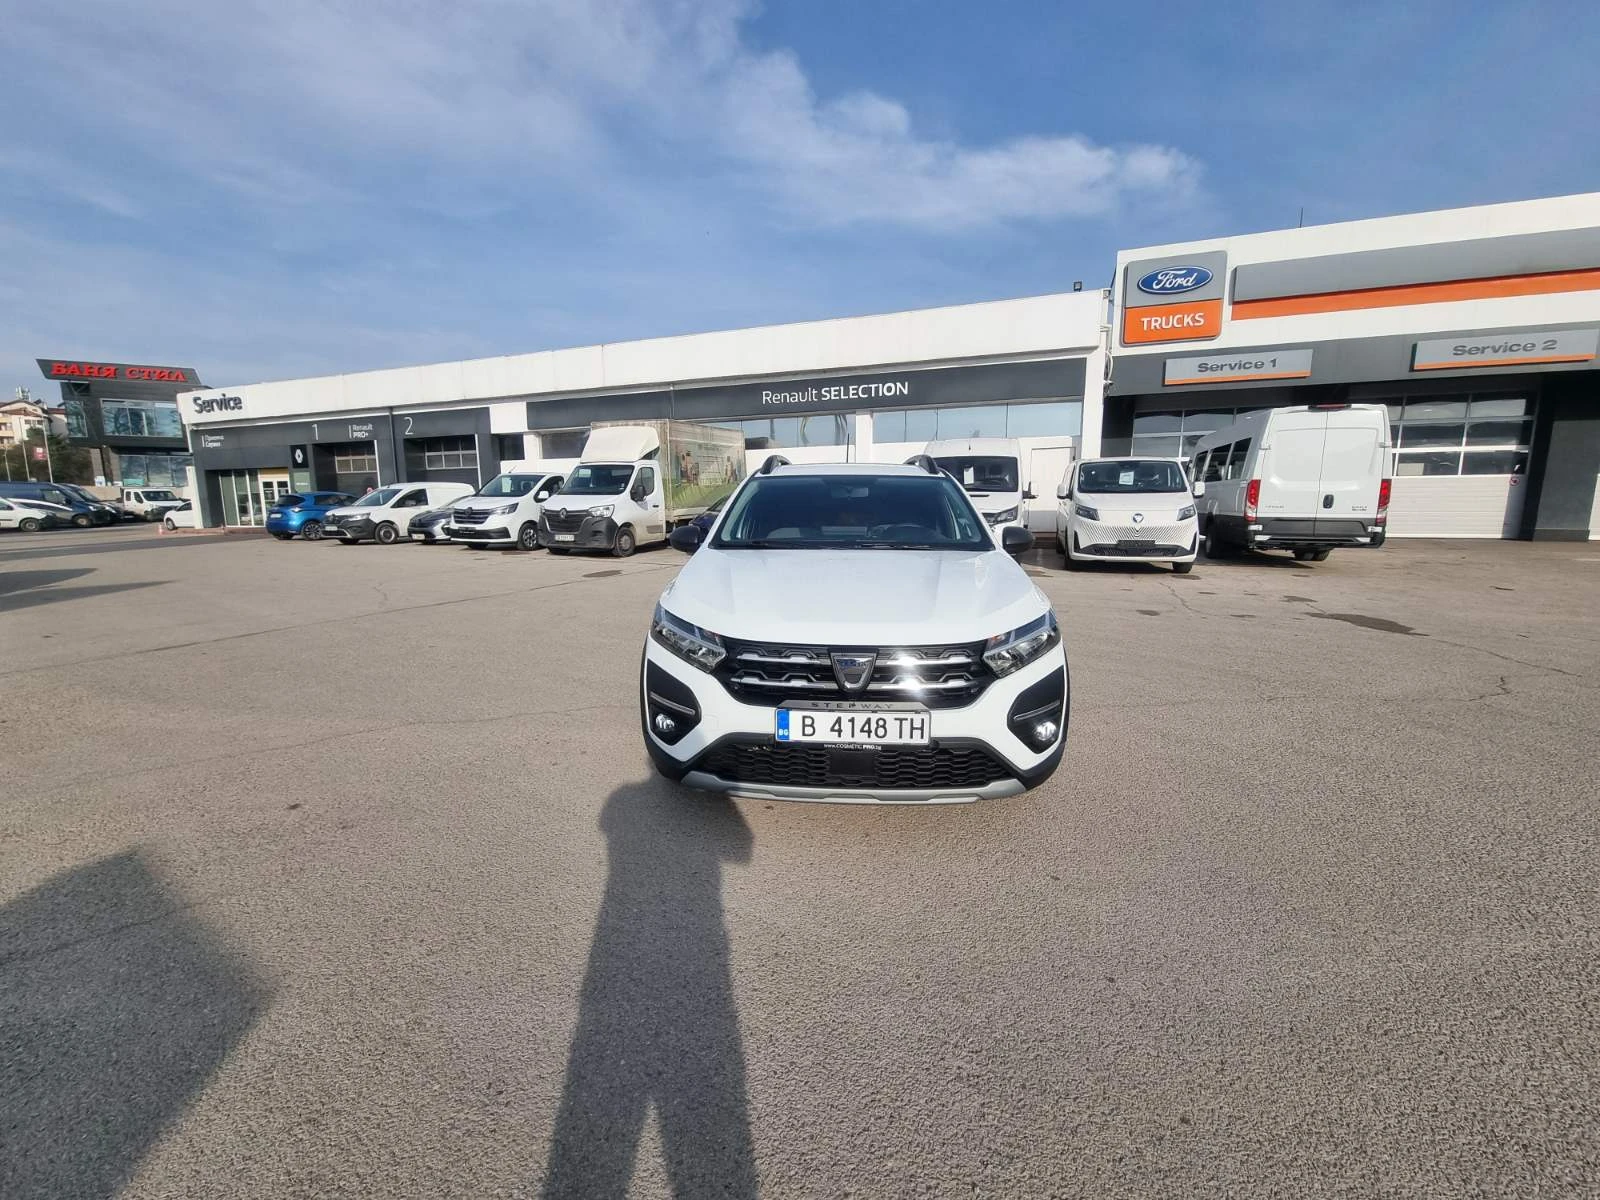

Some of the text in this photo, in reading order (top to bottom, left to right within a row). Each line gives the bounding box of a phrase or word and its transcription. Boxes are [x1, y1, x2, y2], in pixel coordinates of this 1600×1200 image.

[1152, 269, 1198, 289] Ford
[1141, 312, 1205, 331] TRUCKS
[1452, 339, 1558, 356] Service 2
[52, 362, 188, 382] БАНЯ СТИЛ
[1197, 358, 1278, 373] Service 1
[762, 382, 909, 405] Renault SELECTION
[192, 393, 243, 414] Service
[312, 423, 319, 441] 1
[352, 423, 373, 431] Renault
[353, 431, 369, 439] PRO+
[403, 416, 415, 436] 2
[810, 701, 895, 709] STEPWAY
[778, 728, 789, 736] BG
[801, 715, 925, 740] B 4148 TH
